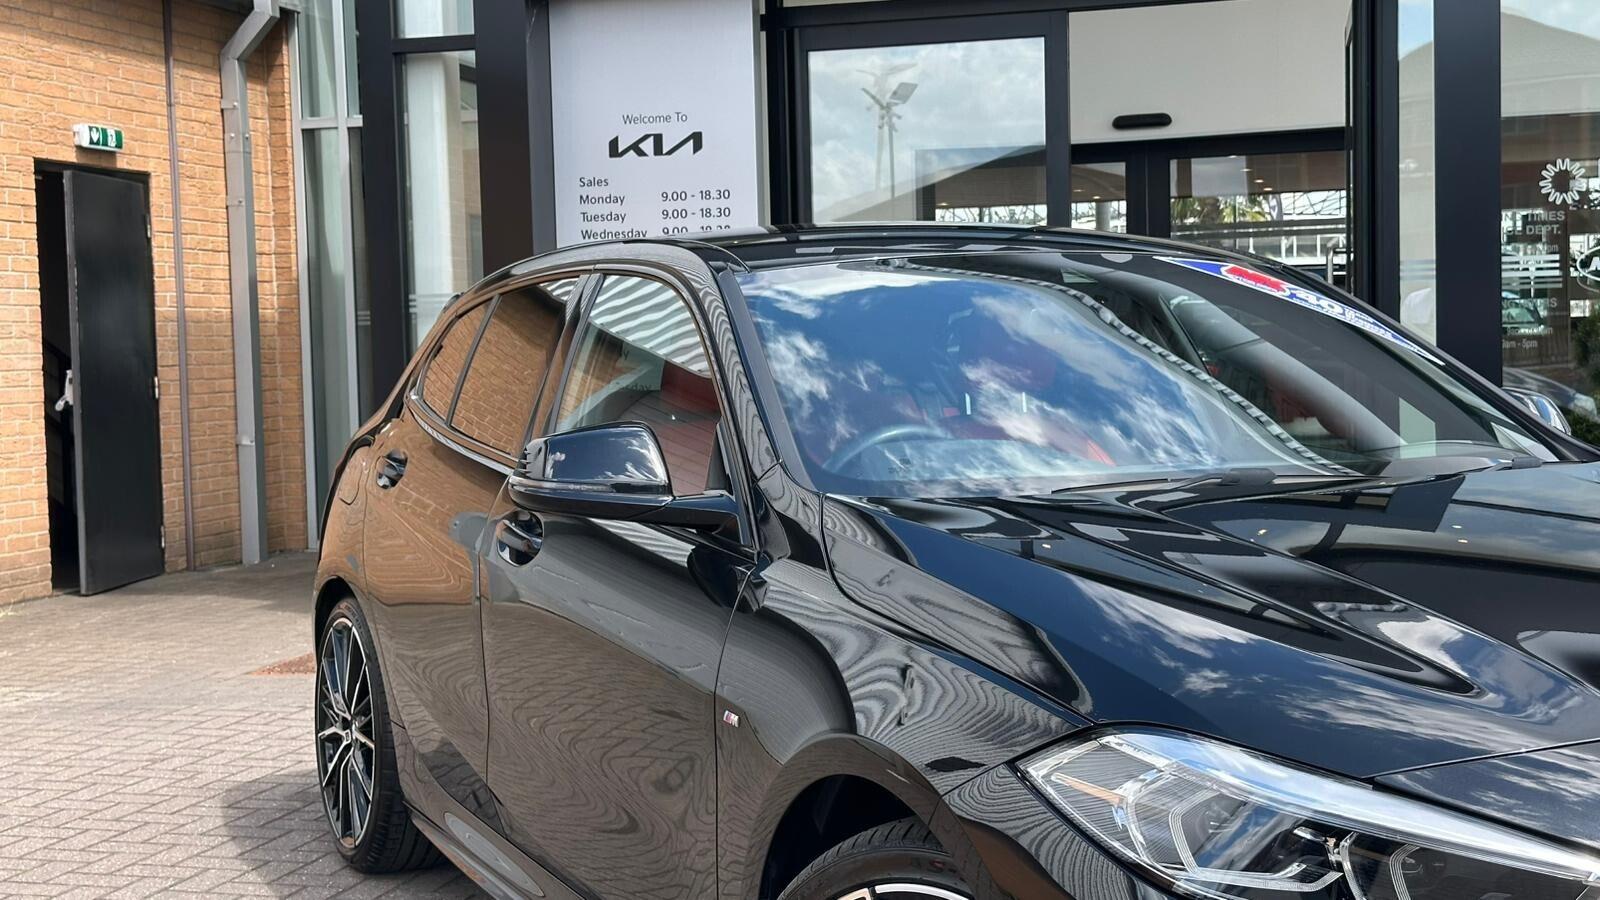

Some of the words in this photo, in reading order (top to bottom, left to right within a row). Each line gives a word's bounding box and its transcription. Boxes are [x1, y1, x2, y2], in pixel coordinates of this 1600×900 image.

[622, 114, 672, 125] Welcome
[675, 111, 688, 123] To
[608, 131, 703, 158] KIA
[579, 177, 609, 188] Sales
[579, 193, 625, 206] Monday
[661, 190, 688, 202] 9.00
[699, 189, 731, 201] 18.30
[580, 212, 627, 224] Tuesday
[661, 208, 688, 220] 9.00
[700, 207, 731, 218] 18.30
[580, 228, 648, 240] Wednesday
